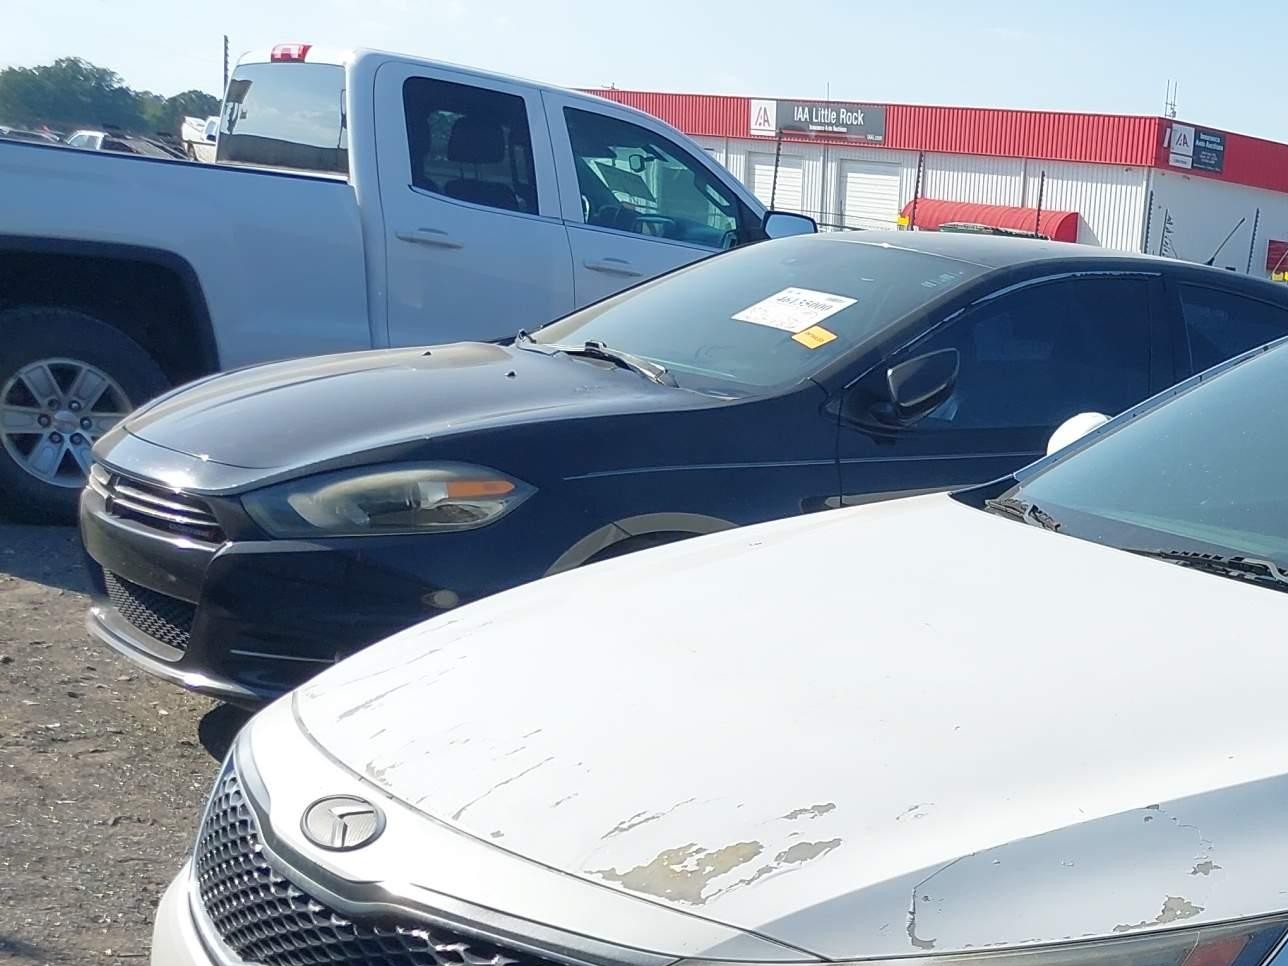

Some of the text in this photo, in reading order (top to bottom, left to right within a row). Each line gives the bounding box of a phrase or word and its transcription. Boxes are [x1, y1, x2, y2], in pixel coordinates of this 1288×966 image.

[794, 106, 864, 126] IAA Little Rock
